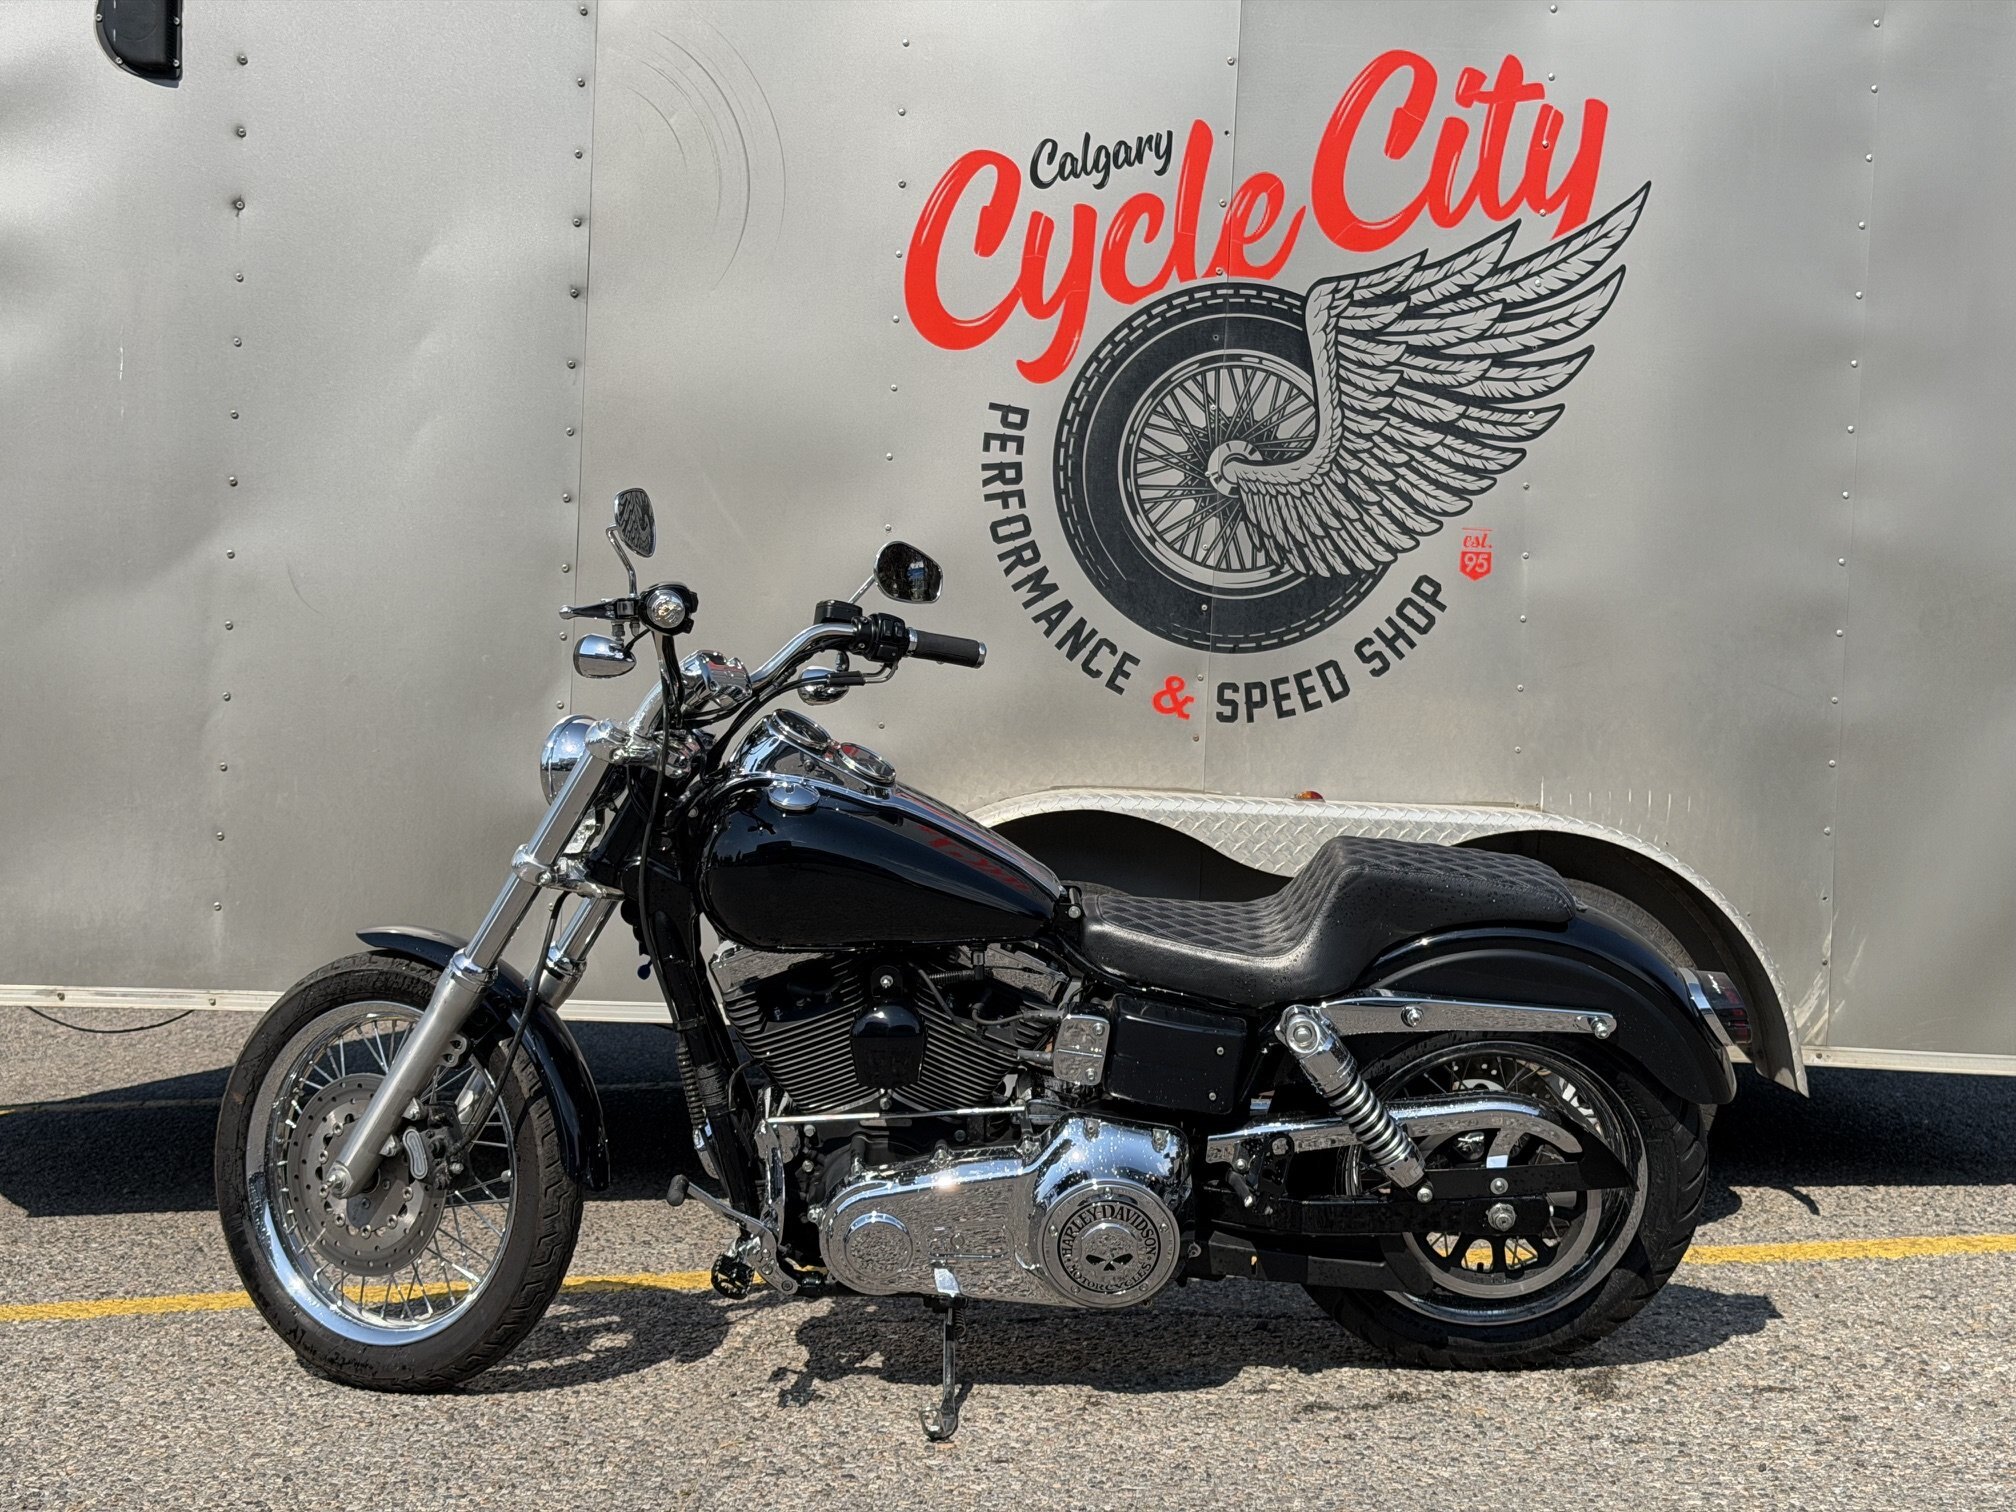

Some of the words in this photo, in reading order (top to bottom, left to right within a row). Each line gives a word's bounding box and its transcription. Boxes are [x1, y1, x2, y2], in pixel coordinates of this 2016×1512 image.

[1029, 129, 1174, 190] Calgary
[904, 118, 1307, 385] Cycle
[1310, 49, 1610, 254] City
[981, 401, 1142, 697] PERFORMANCE
[1151, 674, 1196, 721] &
[1215, 658, 1352, 724] SPEED
[1353, 572, 1449, 679] SHOP
[1463, 552, 1489, 574] 95
[1061, 1203, 1157, 1257] HARLEY-DAVIDSON
